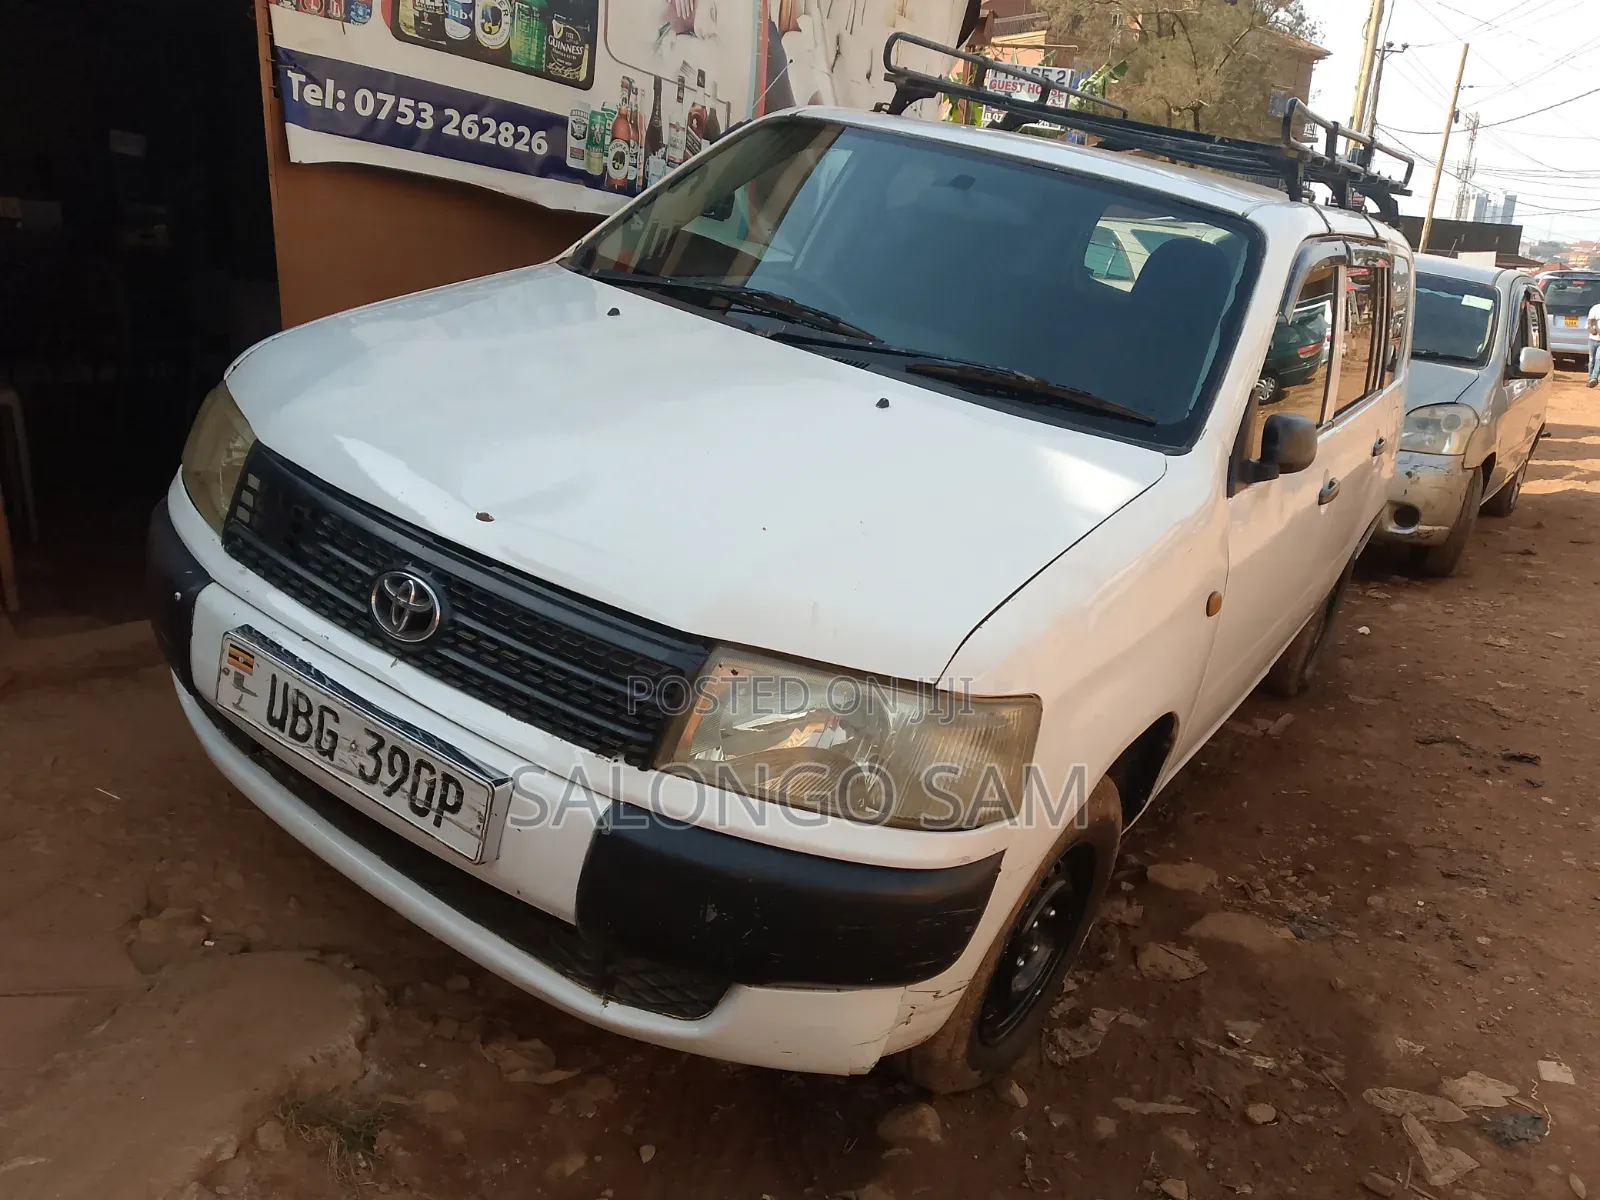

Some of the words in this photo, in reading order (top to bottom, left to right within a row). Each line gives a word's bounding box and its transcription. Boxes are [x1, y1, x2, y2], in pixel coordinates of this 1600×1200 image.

[445, 3, 468, 20] Club
[548, 35, 584, 55] GUINNESS
[1056, 70, 1066, 85] 2
[989, 80, 1025, 93] GUEST
[1027, 84, 1064, 99] HOSE
[287, 70, 345, 112] Tel:
[354, 88, 434, 130] 0753
[441, 109, 549, 155] 262826
[266, 673, 340, 762] UBG
[358, 727, 464, 828] 390P
